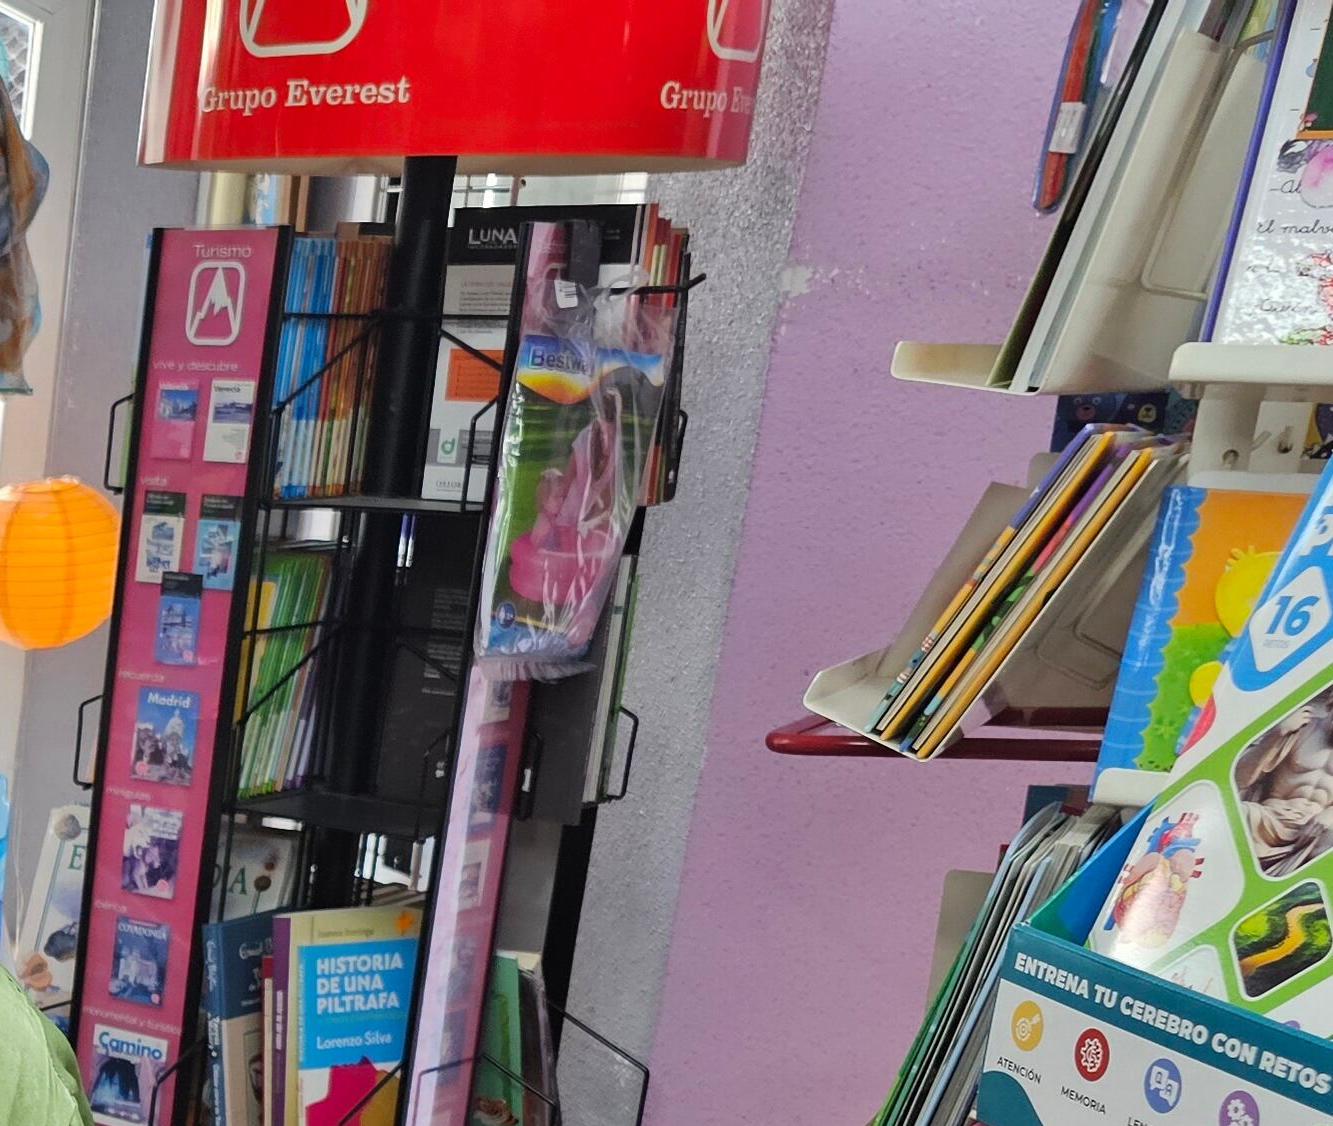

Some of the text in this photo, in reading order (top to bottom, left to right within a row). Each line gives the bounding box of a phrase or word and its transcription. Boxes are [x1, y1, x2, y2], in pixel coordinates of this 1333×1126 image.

[200, 76, 410, 115] Grupo Everest
[661, 81, 727, 114] Grupo
[468, 228, 518, 246] LUNA
[194, 244, 252, 258] Turismo
[186, 360, 239, 372] descubre
[1266, 595, 1320, 637] 16
[147, 692, 191, 709] Madrid
[316, 952, 403, 977] HISTORIA
[316, 974, 383, 995] DE UNA
[316, 992, 400, 1016] PILTRAFA
[1014, 952, 1332, 1096] ENTRENA TU CEREBRO CON RETOS
[99, 1031, 163, 1060] Camino
[316, 1031, 392, 1050] Lorenzo Silva
[997, 1055, 1041, 1085] ATENCIÓN
[1061, 1085, 1106, 1115] MEMORIA
